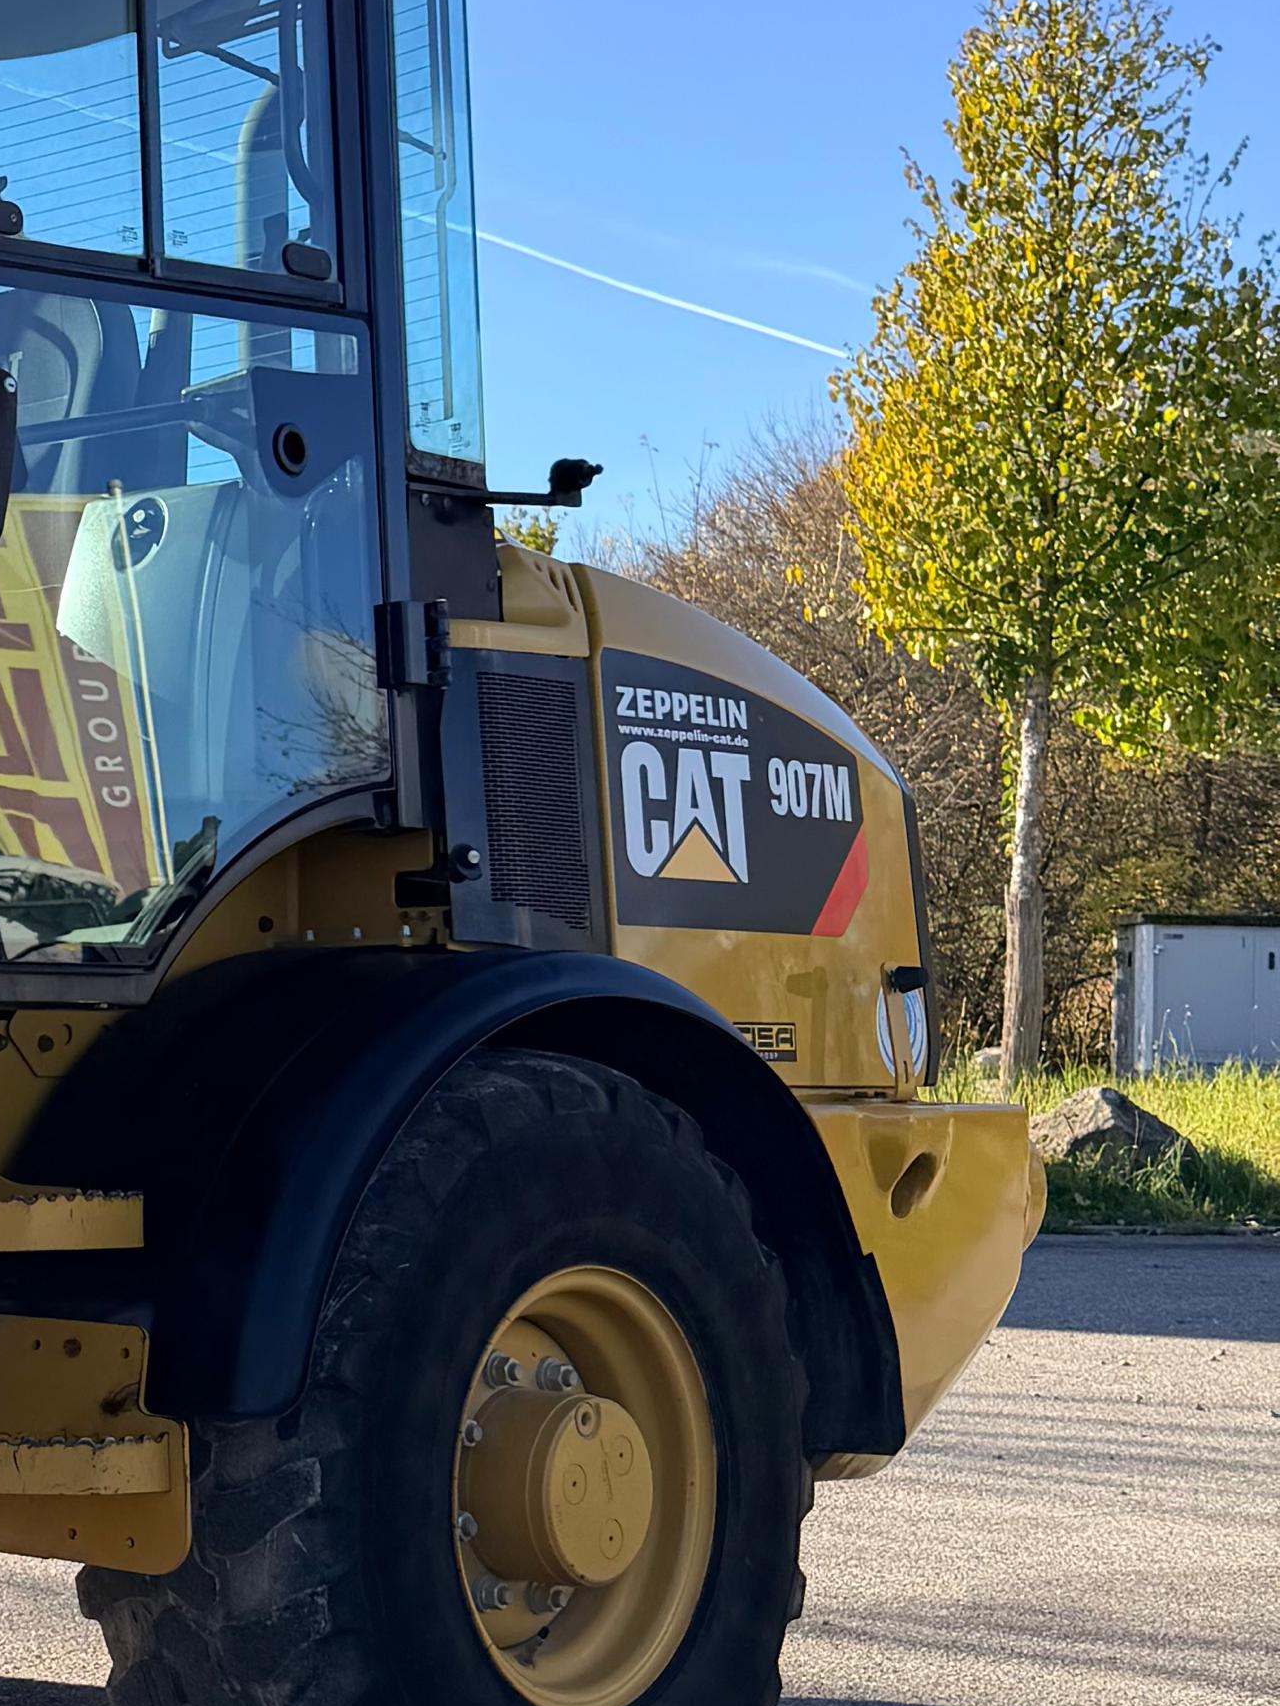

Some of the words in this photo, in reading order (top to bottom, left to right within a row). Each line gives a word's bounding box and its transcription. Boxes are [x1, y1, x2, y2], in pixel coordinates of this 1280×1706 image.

[615, 685, 749, 730] ZEPPELIN
[618, 723, 749, 748] www.zeppelin-cat.de
[621, 741, 751, 884] CAT
[767, 756, 853, 823] 907M
